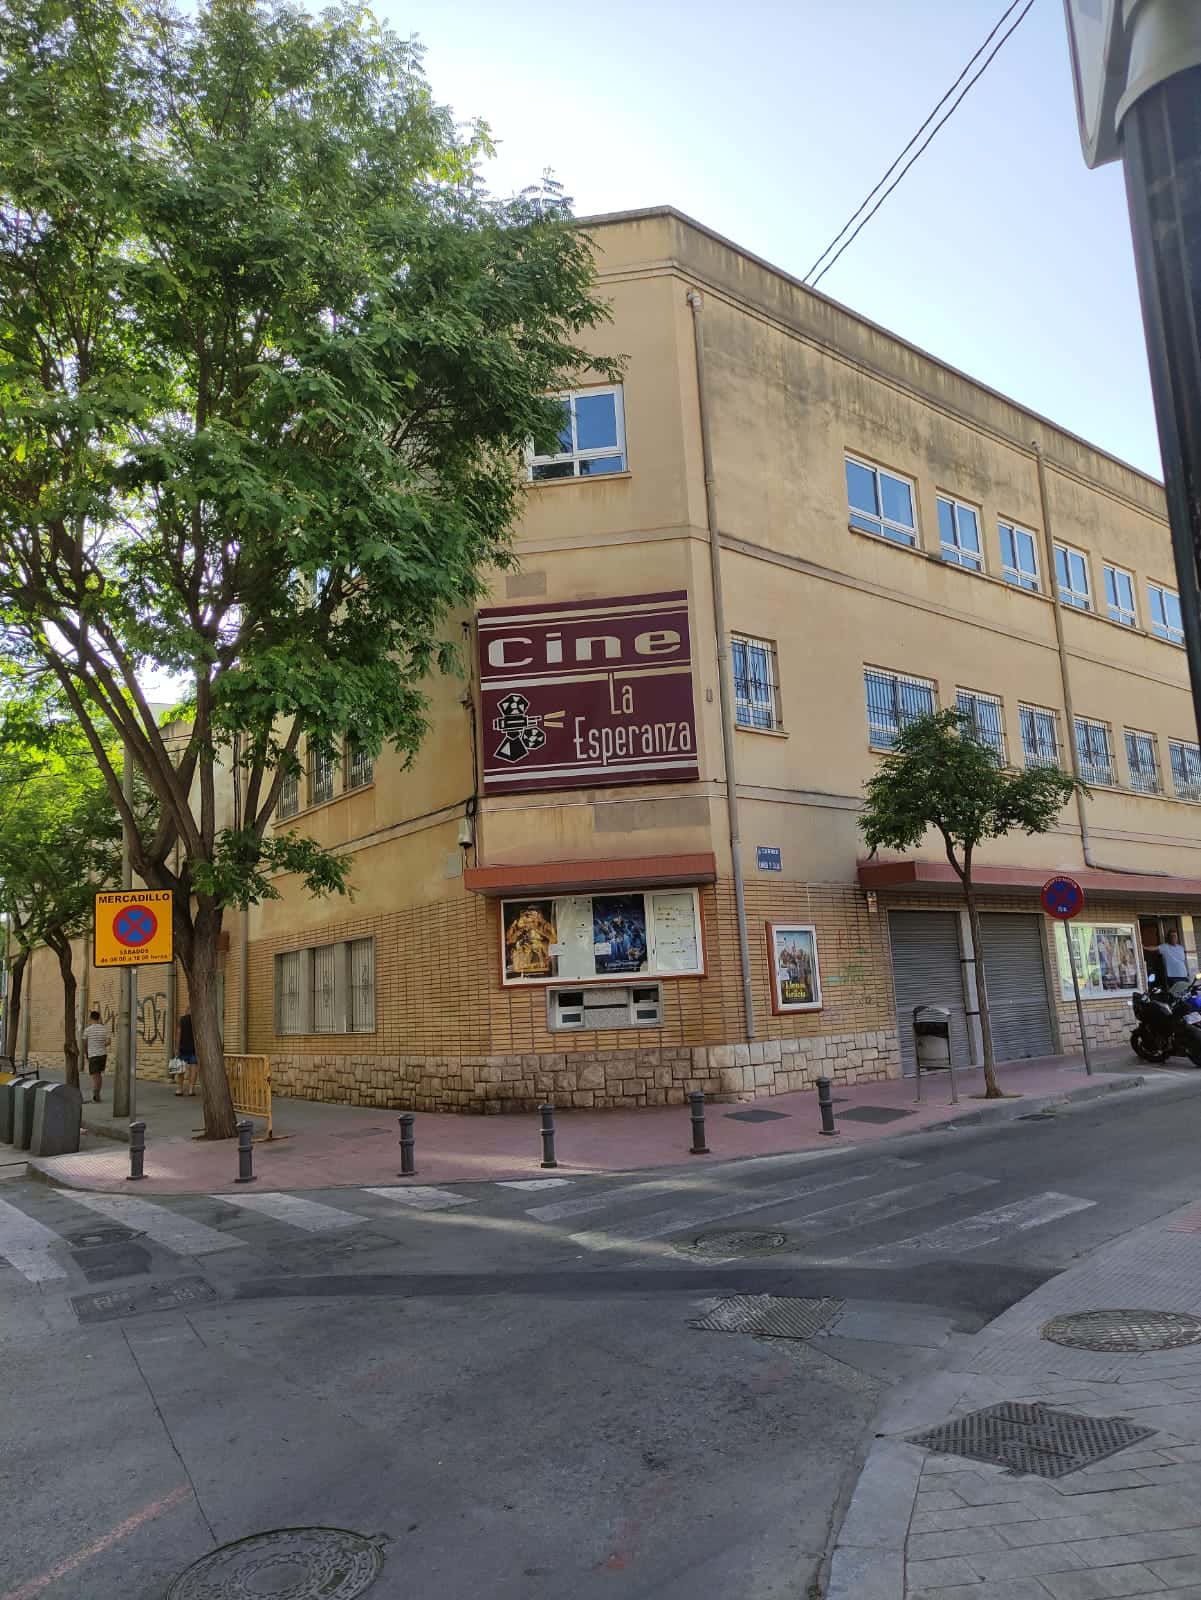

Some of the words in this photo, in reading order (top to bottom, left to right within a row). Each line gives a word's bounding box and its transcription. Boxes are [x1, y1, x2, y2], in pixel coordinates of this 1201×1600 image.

[488, 629, 681, 668] Cine
[608, 672, 634, 715] La
[573, 716, 692, 765] Esperanza
[98, 893, 170, 904] MERCADILLO
